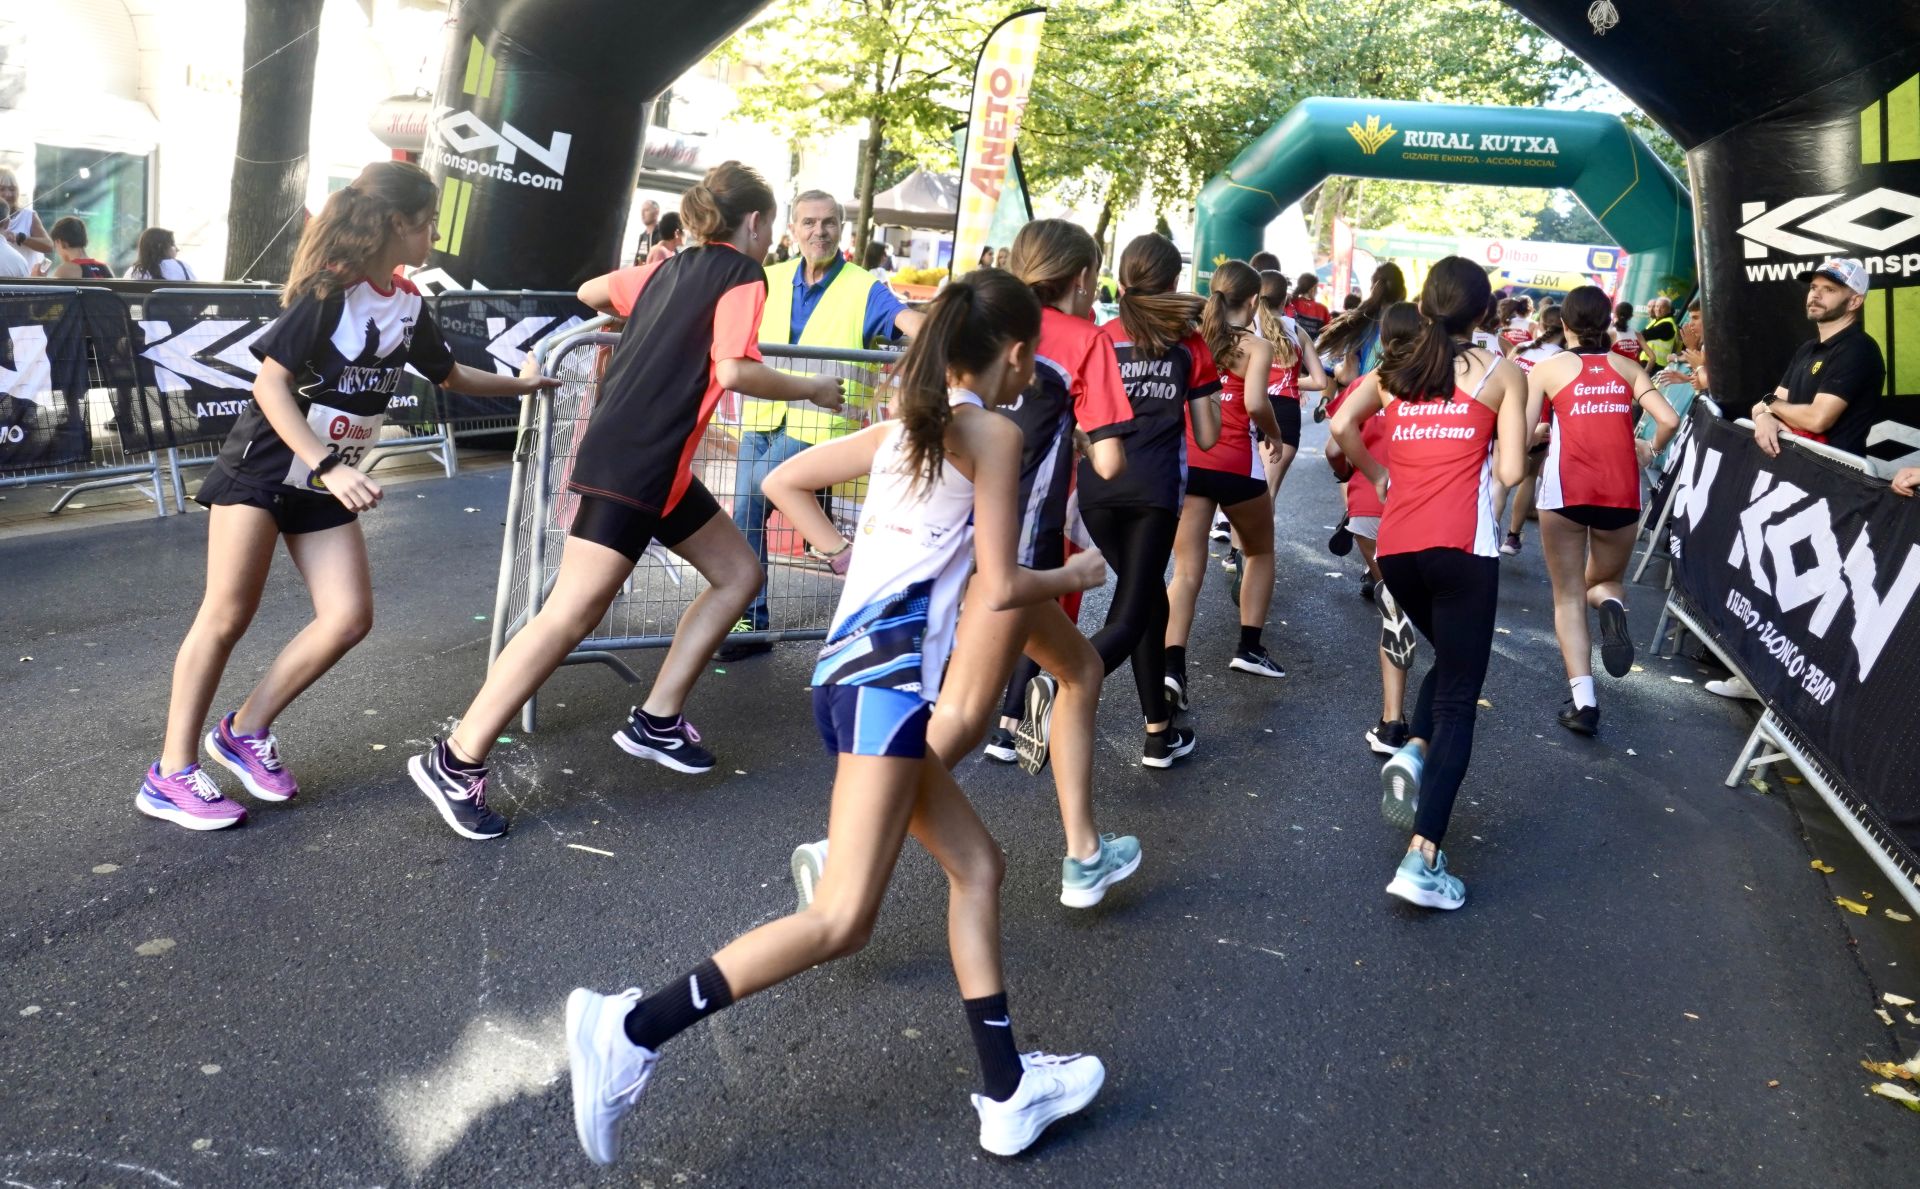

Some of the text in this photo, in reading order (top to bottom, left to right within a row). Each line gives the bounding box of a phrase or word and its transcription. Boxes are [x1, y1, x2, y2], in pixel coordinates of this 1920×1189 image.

[386, 112, 428, 137] Helad
[969, 67, 1014, 202] ANETO
[1403, 130, 1560, 154] RURAL KUTXA
[1402, 152, 1440, 161] GIZARTE
[1441, 154, 1480, 164] EKINTZA
[1486, 156, 1521, 166] ACCIÓN
[1523, 158, 1557, 168] SOCIAL
[434, 151, 563, 191] konsports.com
[1736, 187, 1920, 260] KO
[1533, 273, 1560, 288] BM
[1117, 360, 1173, 379] RNIKA
[1574, 379, 1626, 396] Gernika
[1397, 400, 1468, 417] Gernika
[1569, 401, 1630, 416] Atletismo
[1391, 424, 1476, 441] Atletismo
